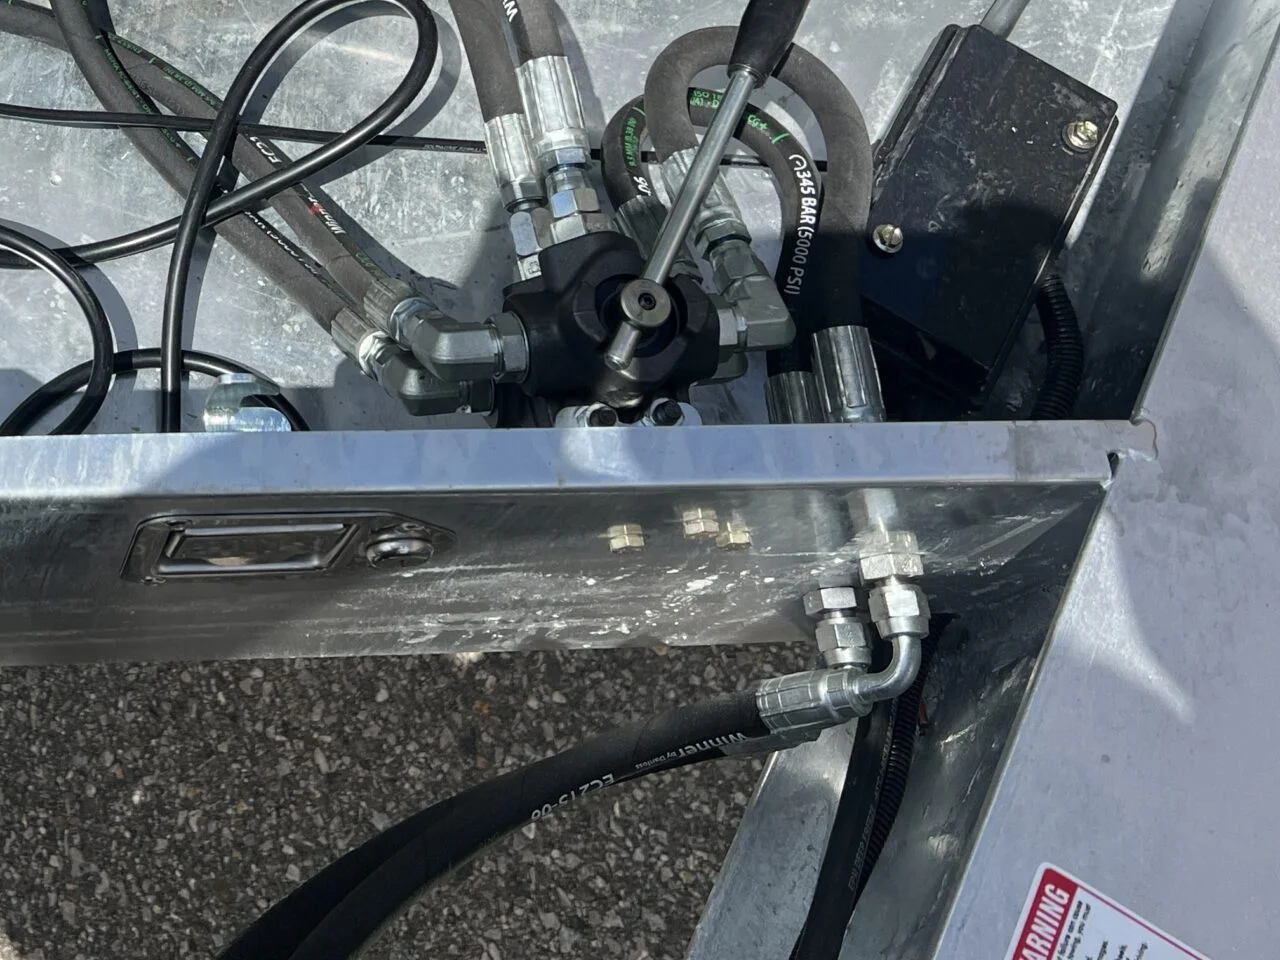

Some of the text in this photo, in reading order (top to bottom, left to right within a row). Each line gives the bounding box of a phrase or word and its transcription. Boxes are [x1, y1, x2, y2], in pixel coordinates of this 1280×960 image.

[783, 170, 817, 295] 345 BAR (5000 PSI)
[678, 731, 746, 758] Winner
[1019, 883, 1070, 960] ARNING
